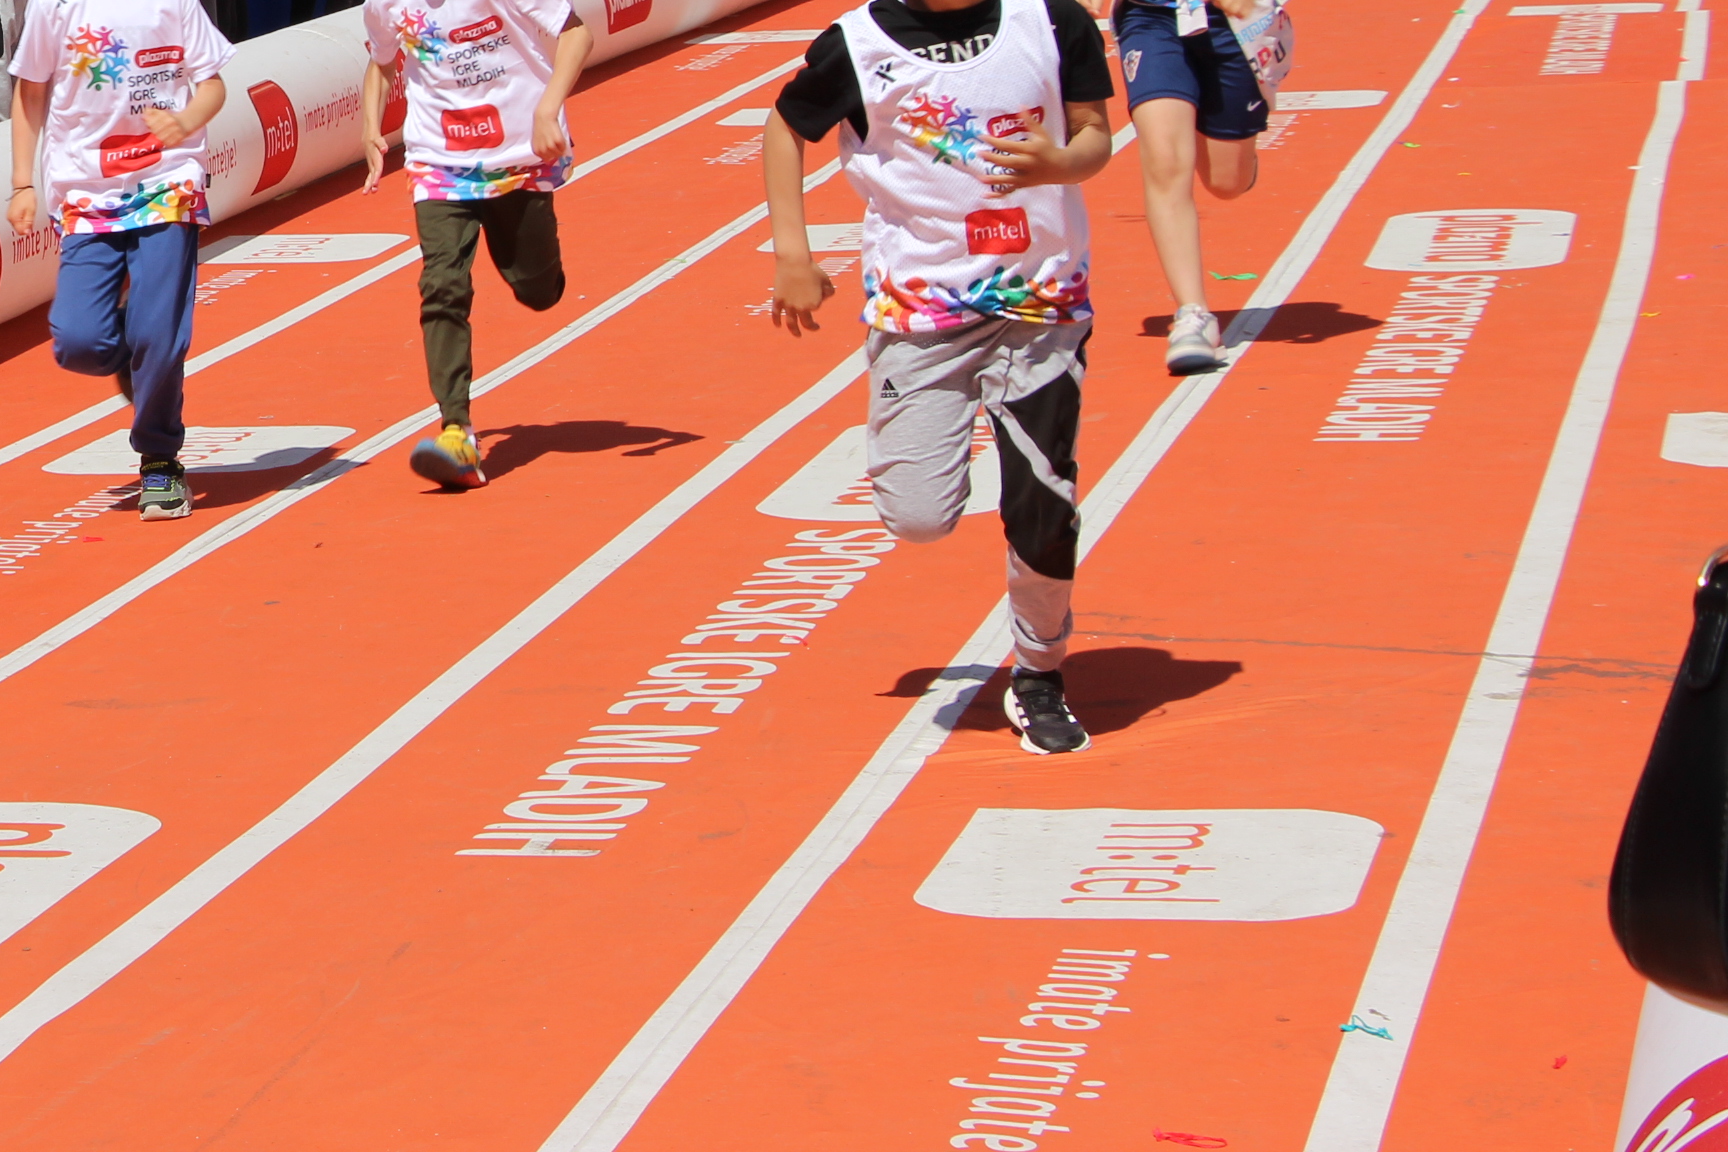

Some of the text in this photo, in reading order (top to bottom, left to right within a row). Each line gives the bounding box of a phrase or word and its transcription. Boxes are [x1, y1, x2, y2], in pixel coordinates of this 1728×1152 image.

[453, 19, 498, 43] plazma
[138, 49, 181, 67] plazma
[446, 34, 511, 64] SPORTSKE
[128, 68, 184, 88] SPORTSKE
[452, 60, 482, 77] IGRE
[456, 65, 506, 89] MLADIH
[129, 88, 157, 102] IGRE
[266, 107, 295, 158] m:tel
[447, 116, 497, 138] m:tel
[974, 218, 1026, 241] m:tel
[1313, 275, 1500, 442] SPORTSKE IGRE MLADIH
[454, 529, 899, 857] SPORTSKE IGRE MLADIH
[1061, 823, 1221, 903] m:tel
[1019, 948, 1170, 1031] imate
